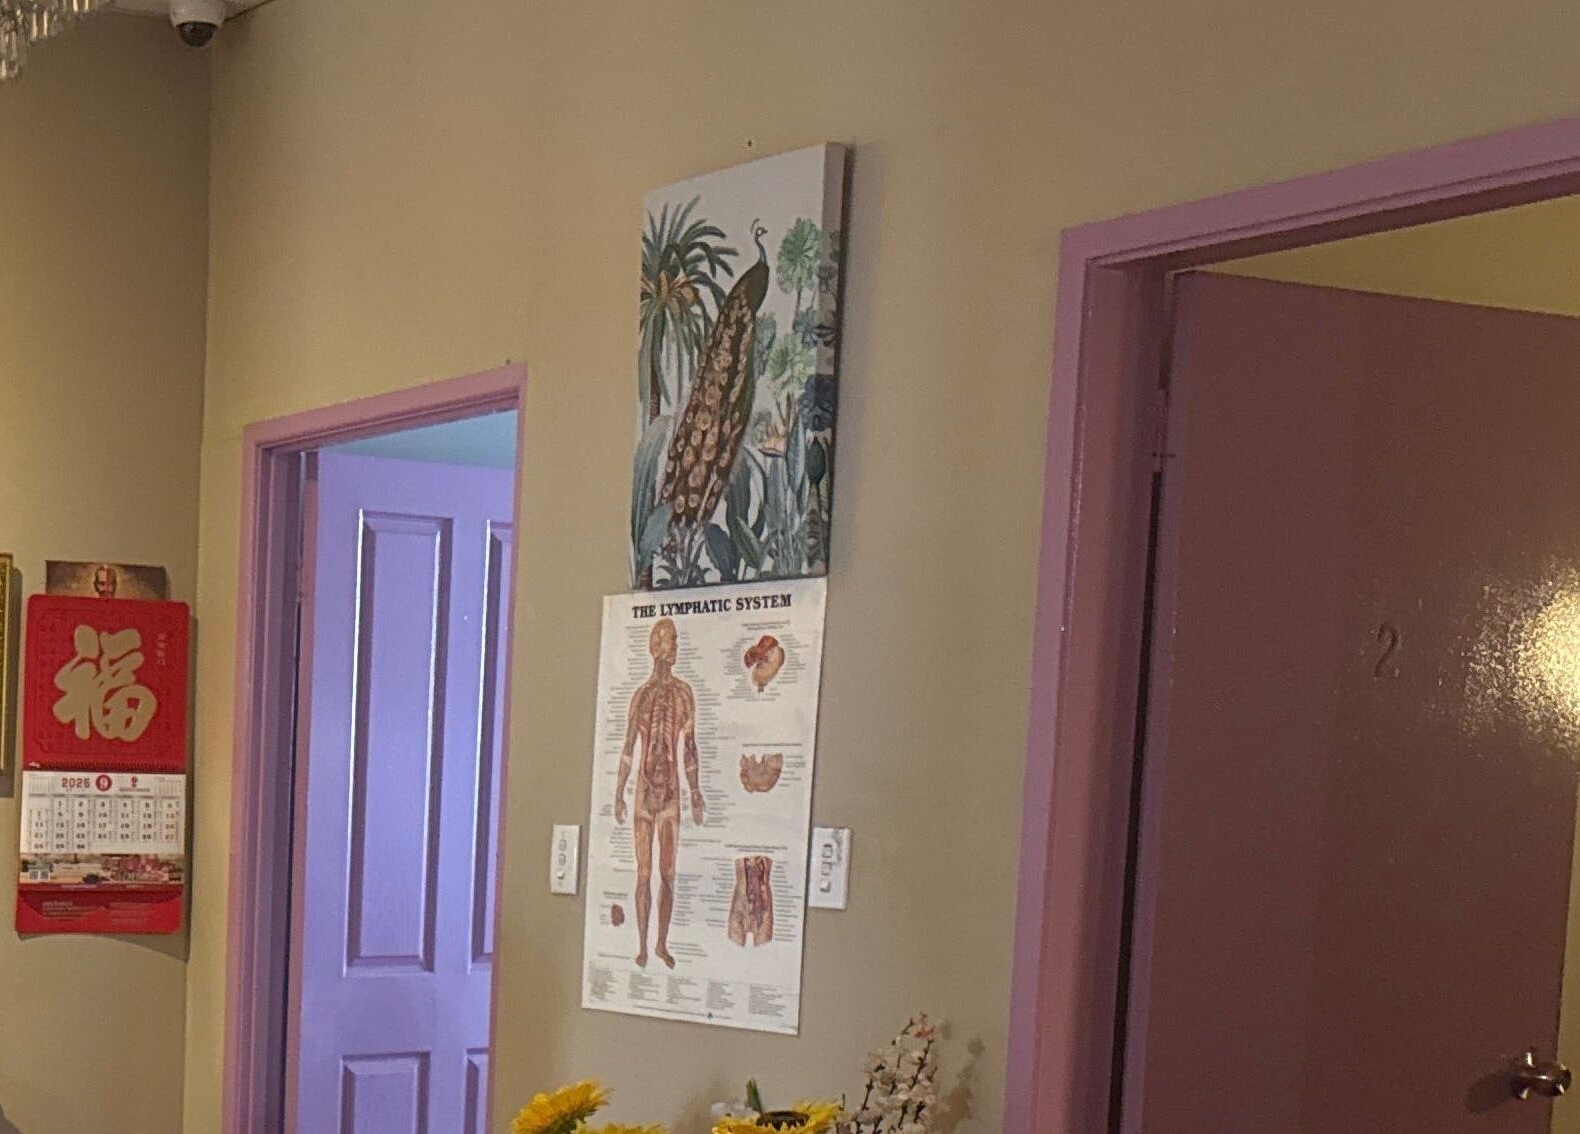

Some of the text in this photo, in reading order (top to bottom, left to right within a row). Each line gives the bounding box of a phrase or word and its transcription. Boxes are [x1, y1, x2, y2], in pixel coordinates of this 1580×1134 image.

[632, 594, 792, 618] THE LYMPHATIC SYSTEM
[52, 624, 158, 742] 福
